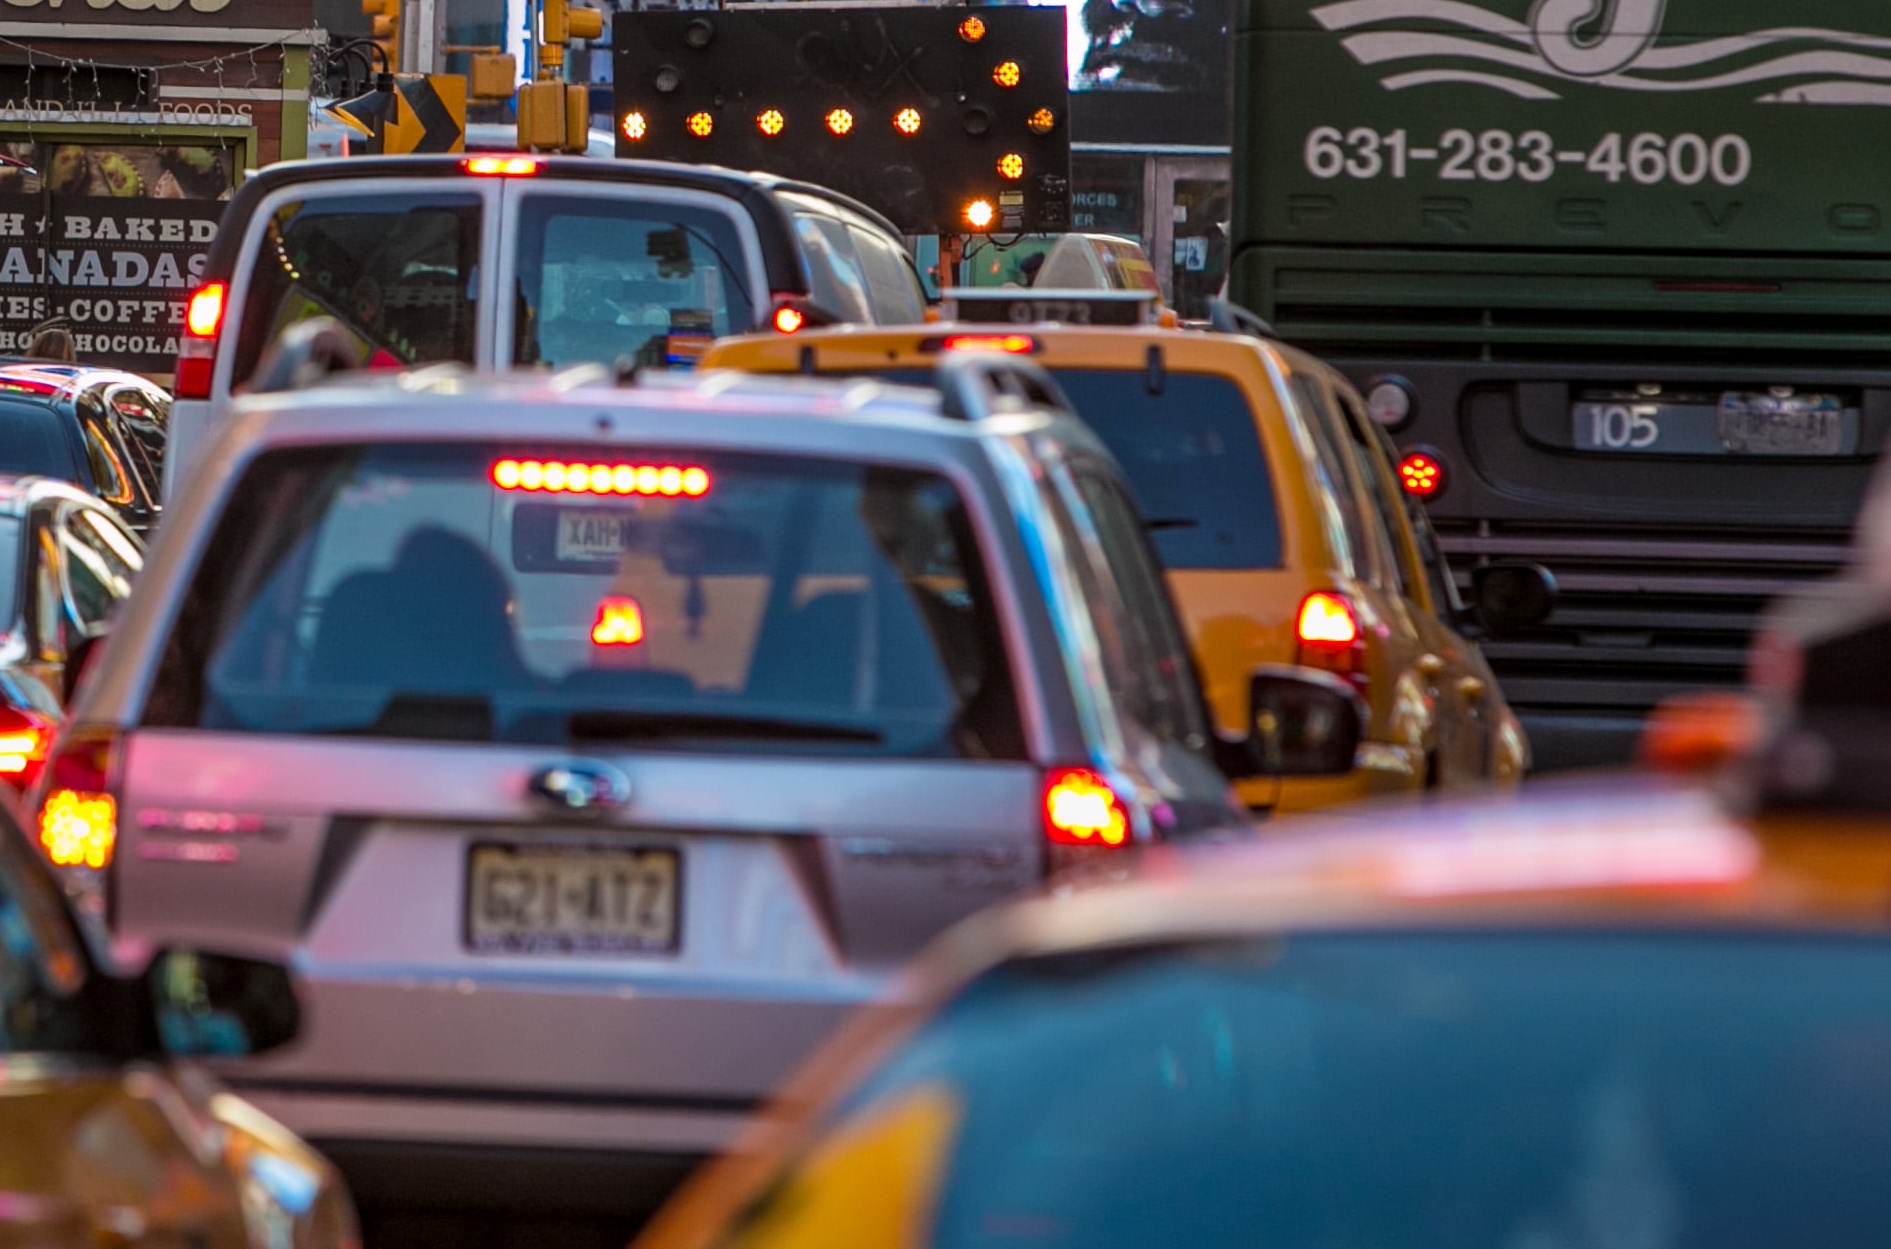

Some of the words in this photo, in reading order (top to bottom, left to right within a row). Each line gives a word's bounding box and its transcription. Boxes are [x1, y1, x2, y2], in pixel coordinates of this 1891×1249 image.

[158, 102, 254, 125] FOODS
[1303, 126, 1752, 186] 631-283-4600
[64, 216, 219, 243] BAKED
[1286, 193, 1891, 239] PREVO
[69, 298, 189, 325] COFFE
[1589, 405, 1659, 448] 105
